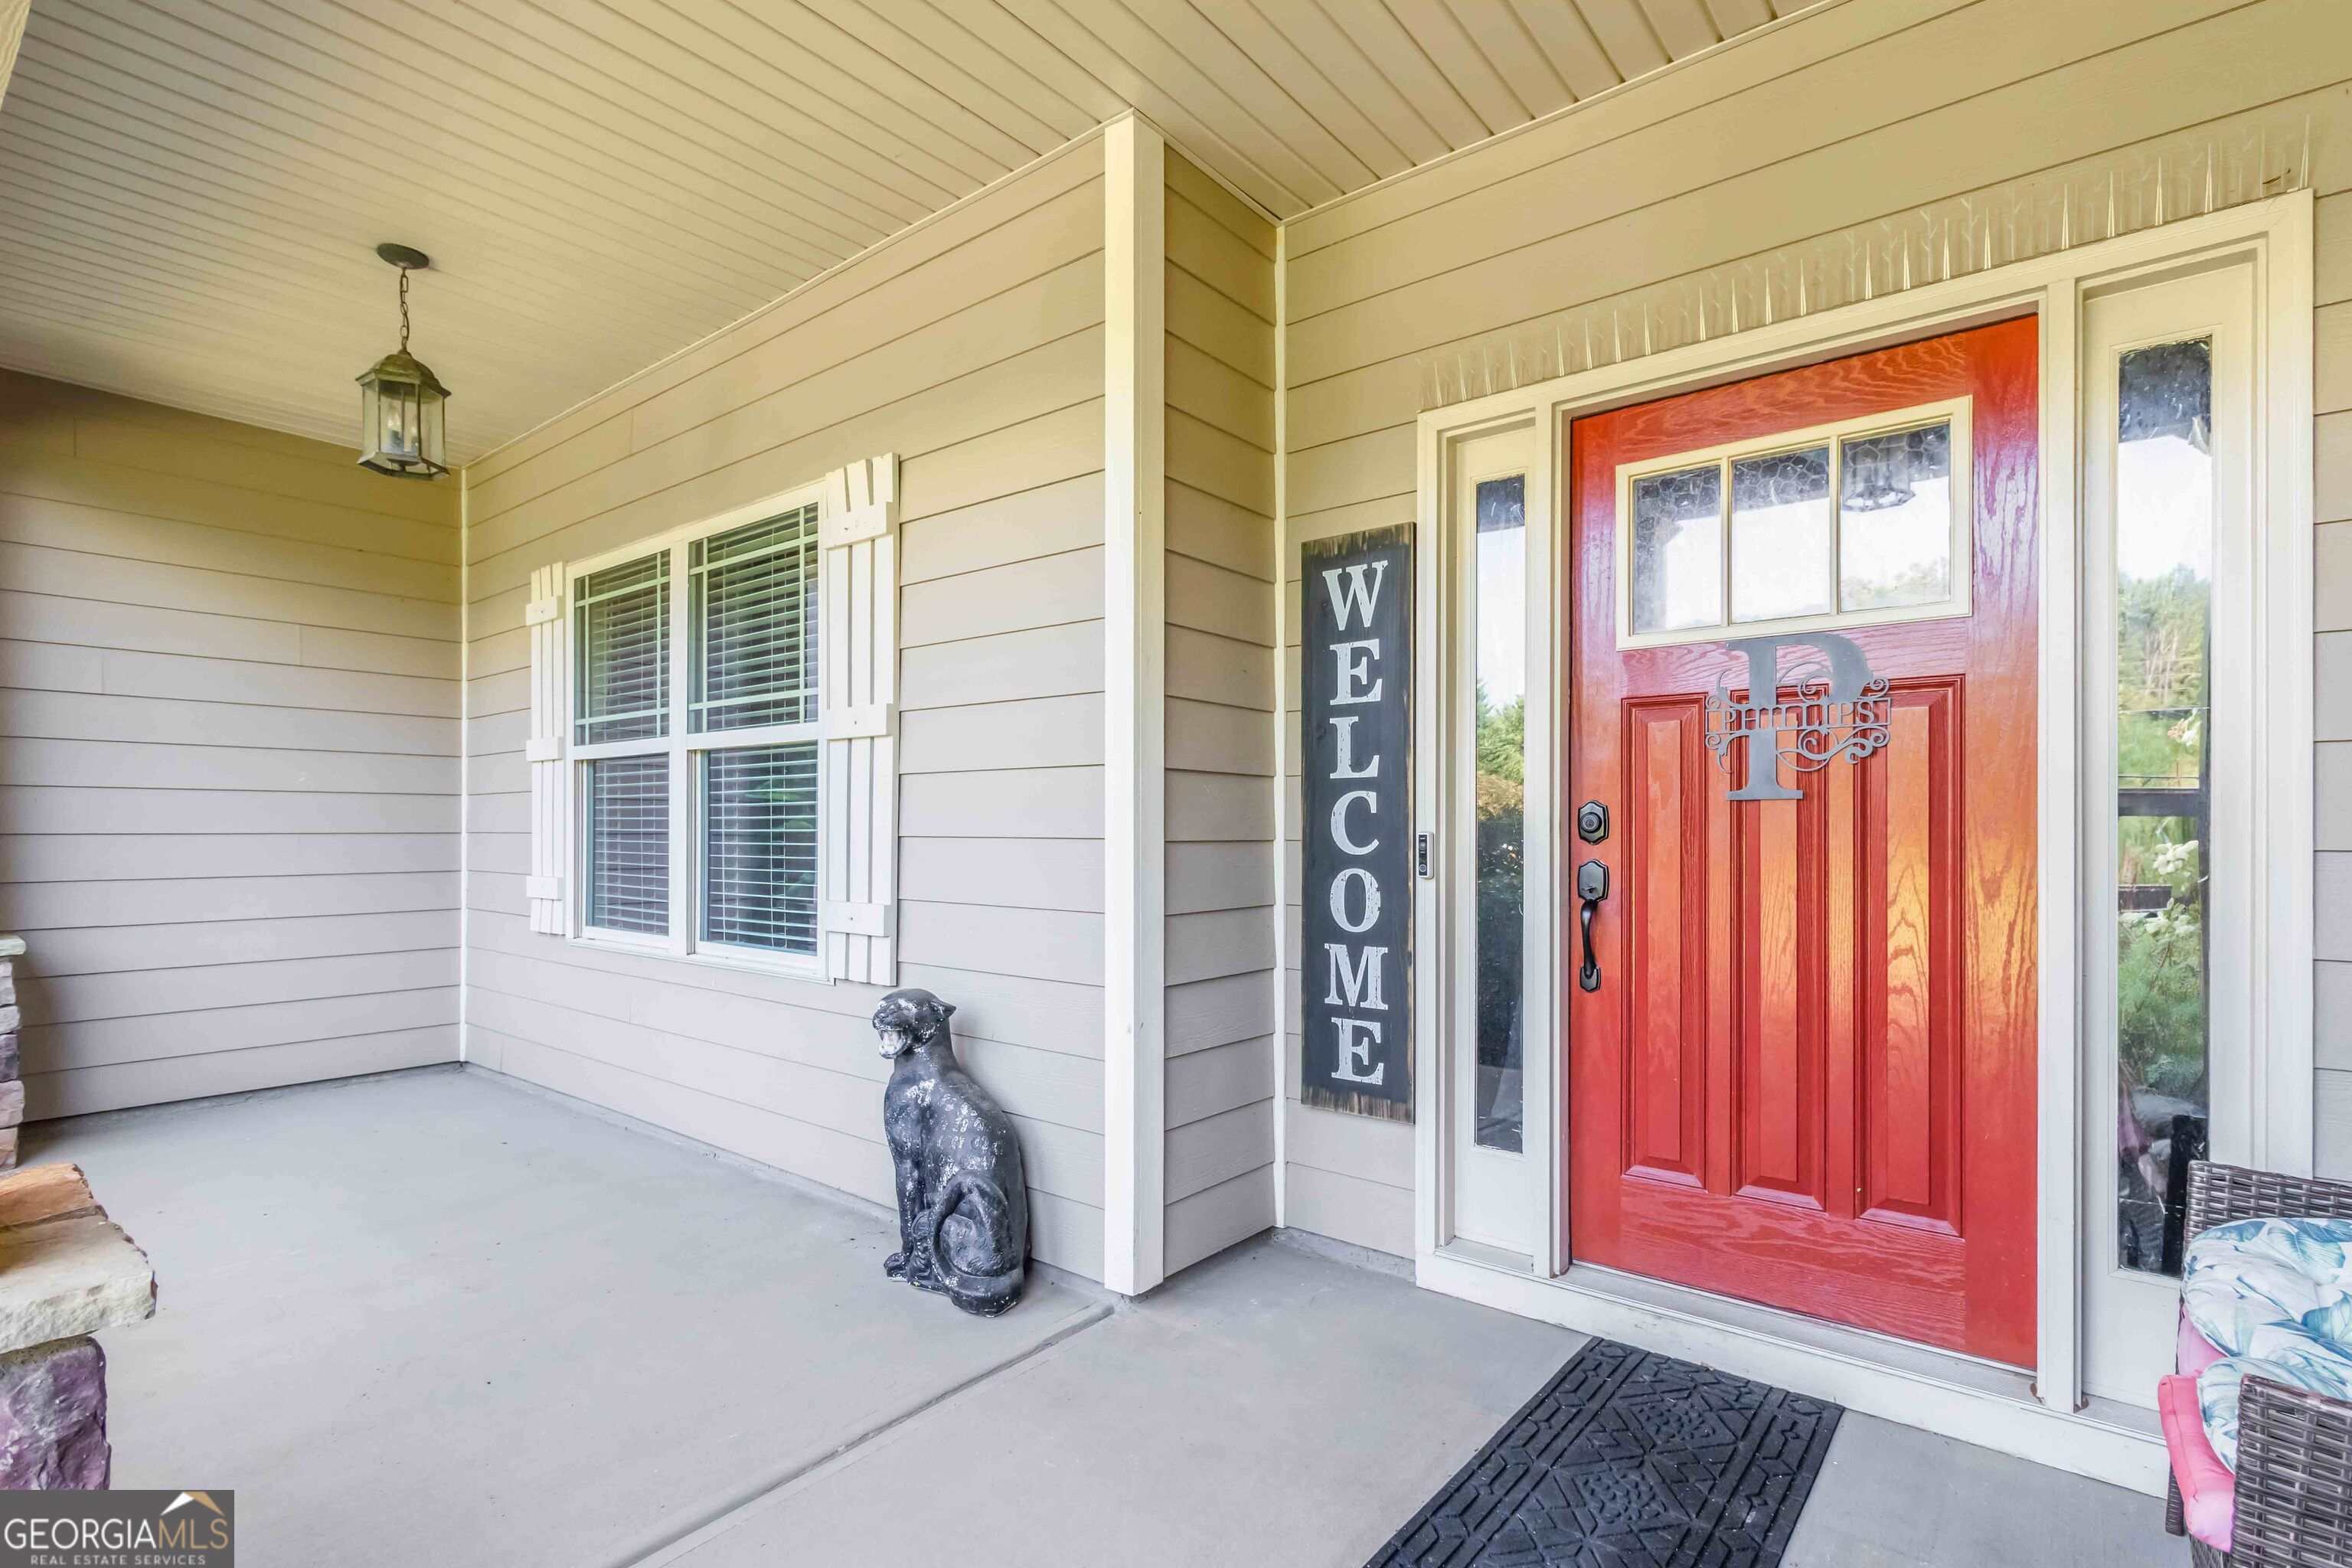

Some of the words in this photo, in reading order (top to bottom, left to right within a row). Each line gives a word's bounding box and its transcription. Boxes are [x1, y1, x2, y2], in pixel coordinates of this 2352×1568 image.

[1720, 700, 1876, 733] PHILLIPS
[1726, 633, 1873, 801] P
[1321, 559, 1389, 1086] WELCOME
